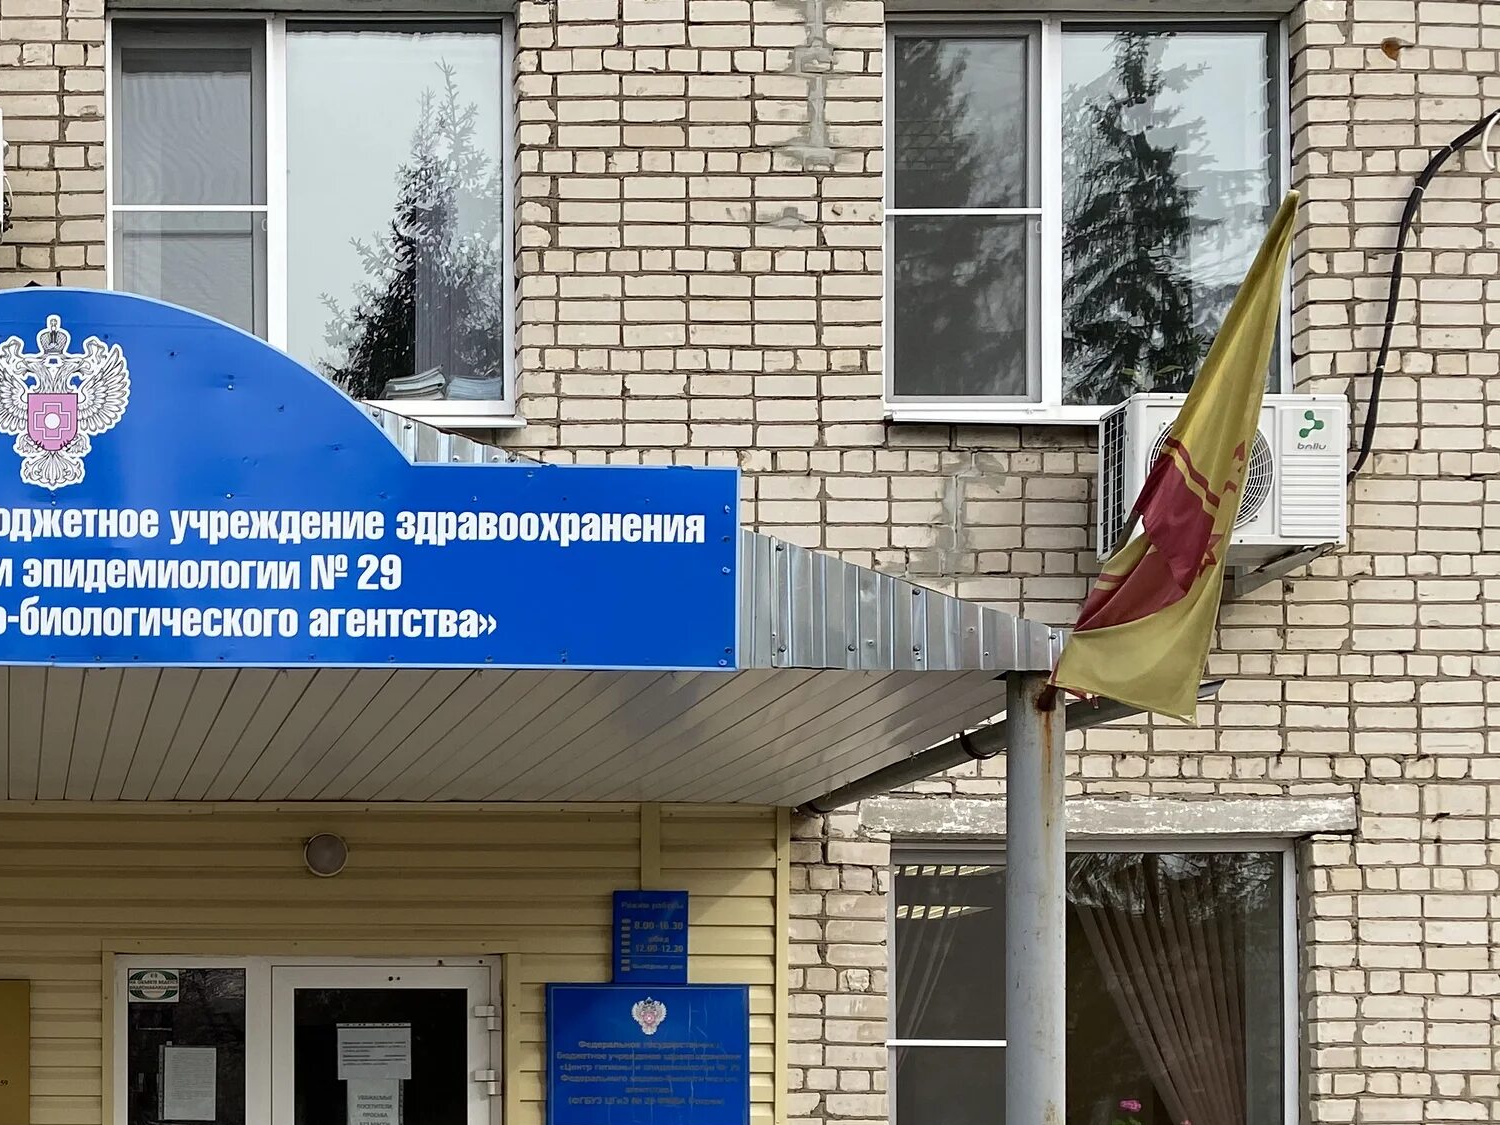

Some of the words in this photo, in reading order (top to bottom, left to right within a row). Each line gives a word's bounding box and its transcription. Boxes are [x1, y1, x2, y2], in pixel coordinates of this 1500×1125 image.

[170, 511, 384, 544] учреждение
[396, 511, 704, 546] здравоохранения
[23, 559, 300, 592] эпидемиологии
[311, 555, 347, 589] №
[358, 554, 401, 590] 29
[310, 609, 496, 637] агентства»
